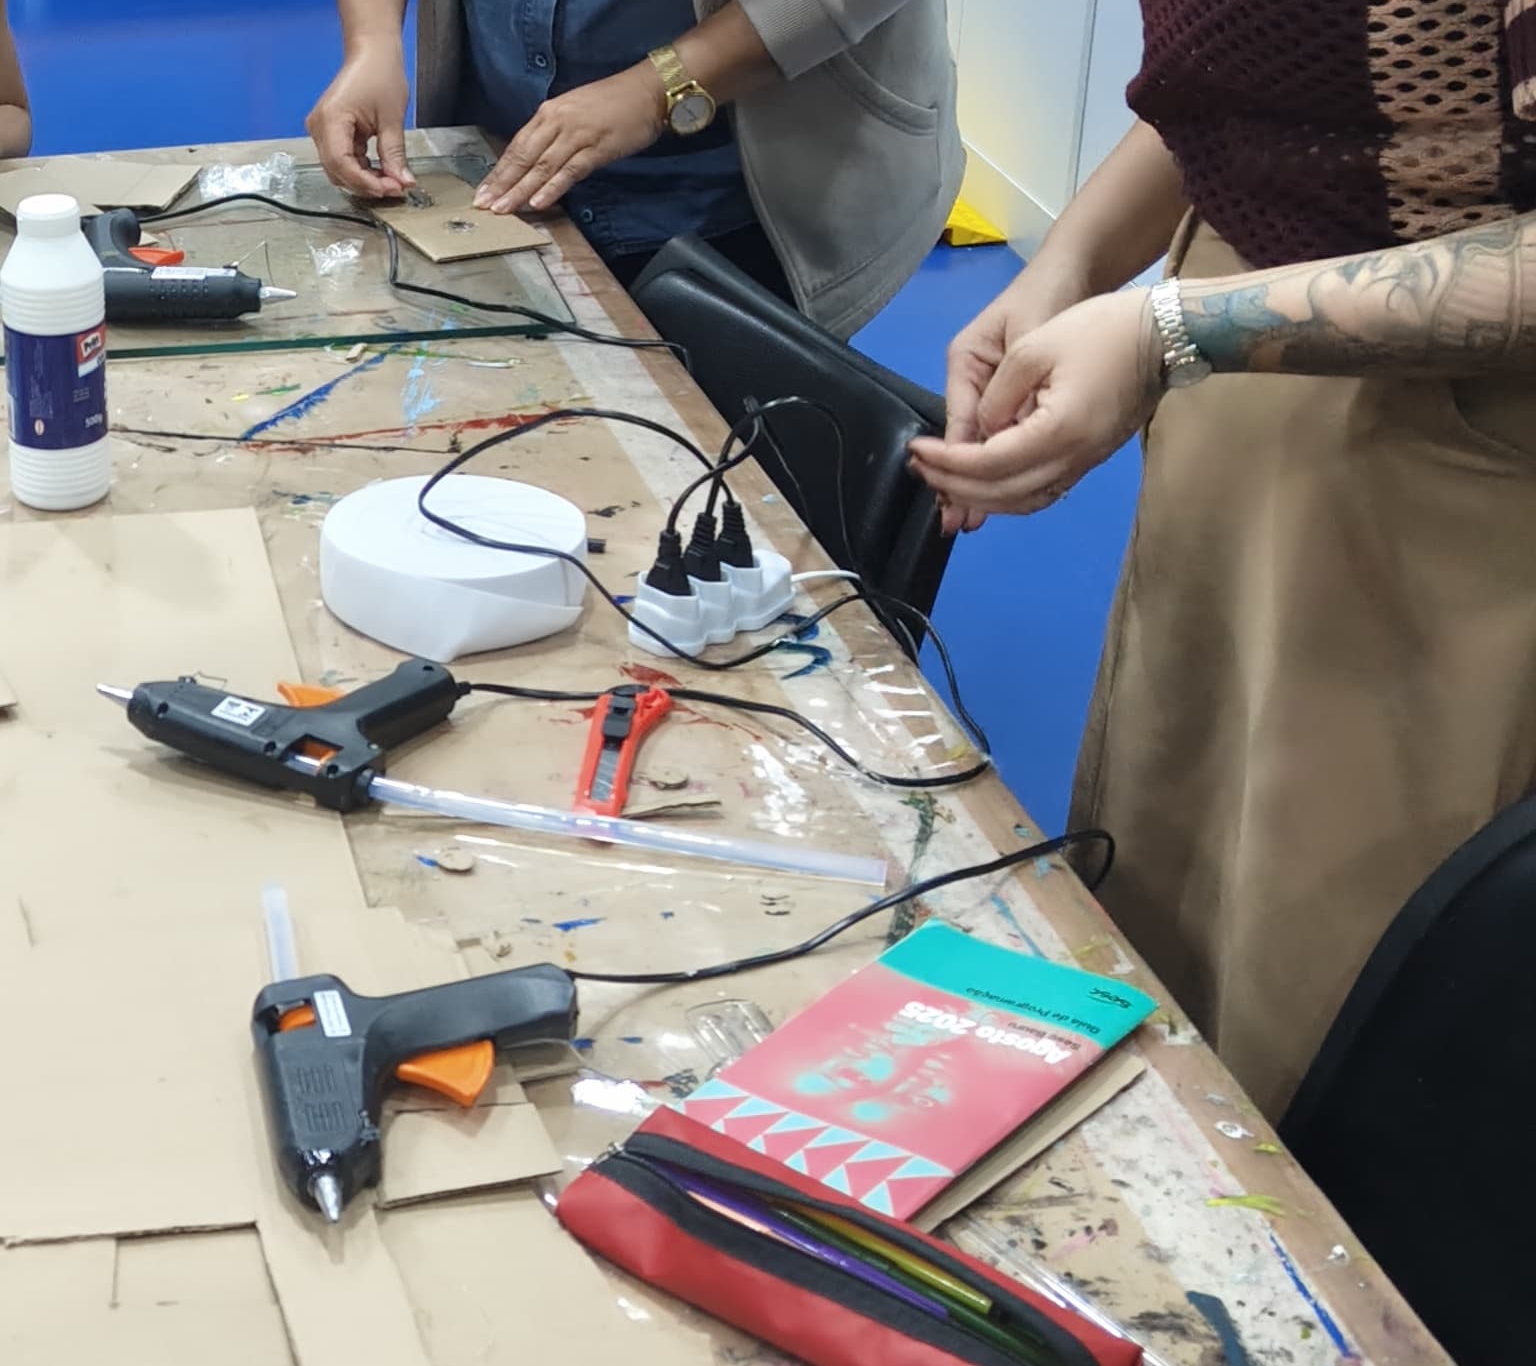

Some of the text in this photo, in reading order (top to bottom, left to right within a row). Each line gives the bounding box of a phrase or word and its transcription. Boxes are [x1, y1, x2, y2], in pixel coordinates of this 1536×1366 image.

[965, 986, 1050, 1018] Programação
[898, 1000, 1073, 1065] Agosto 2025
[1070, 1018, 1101, 1036] Guia
